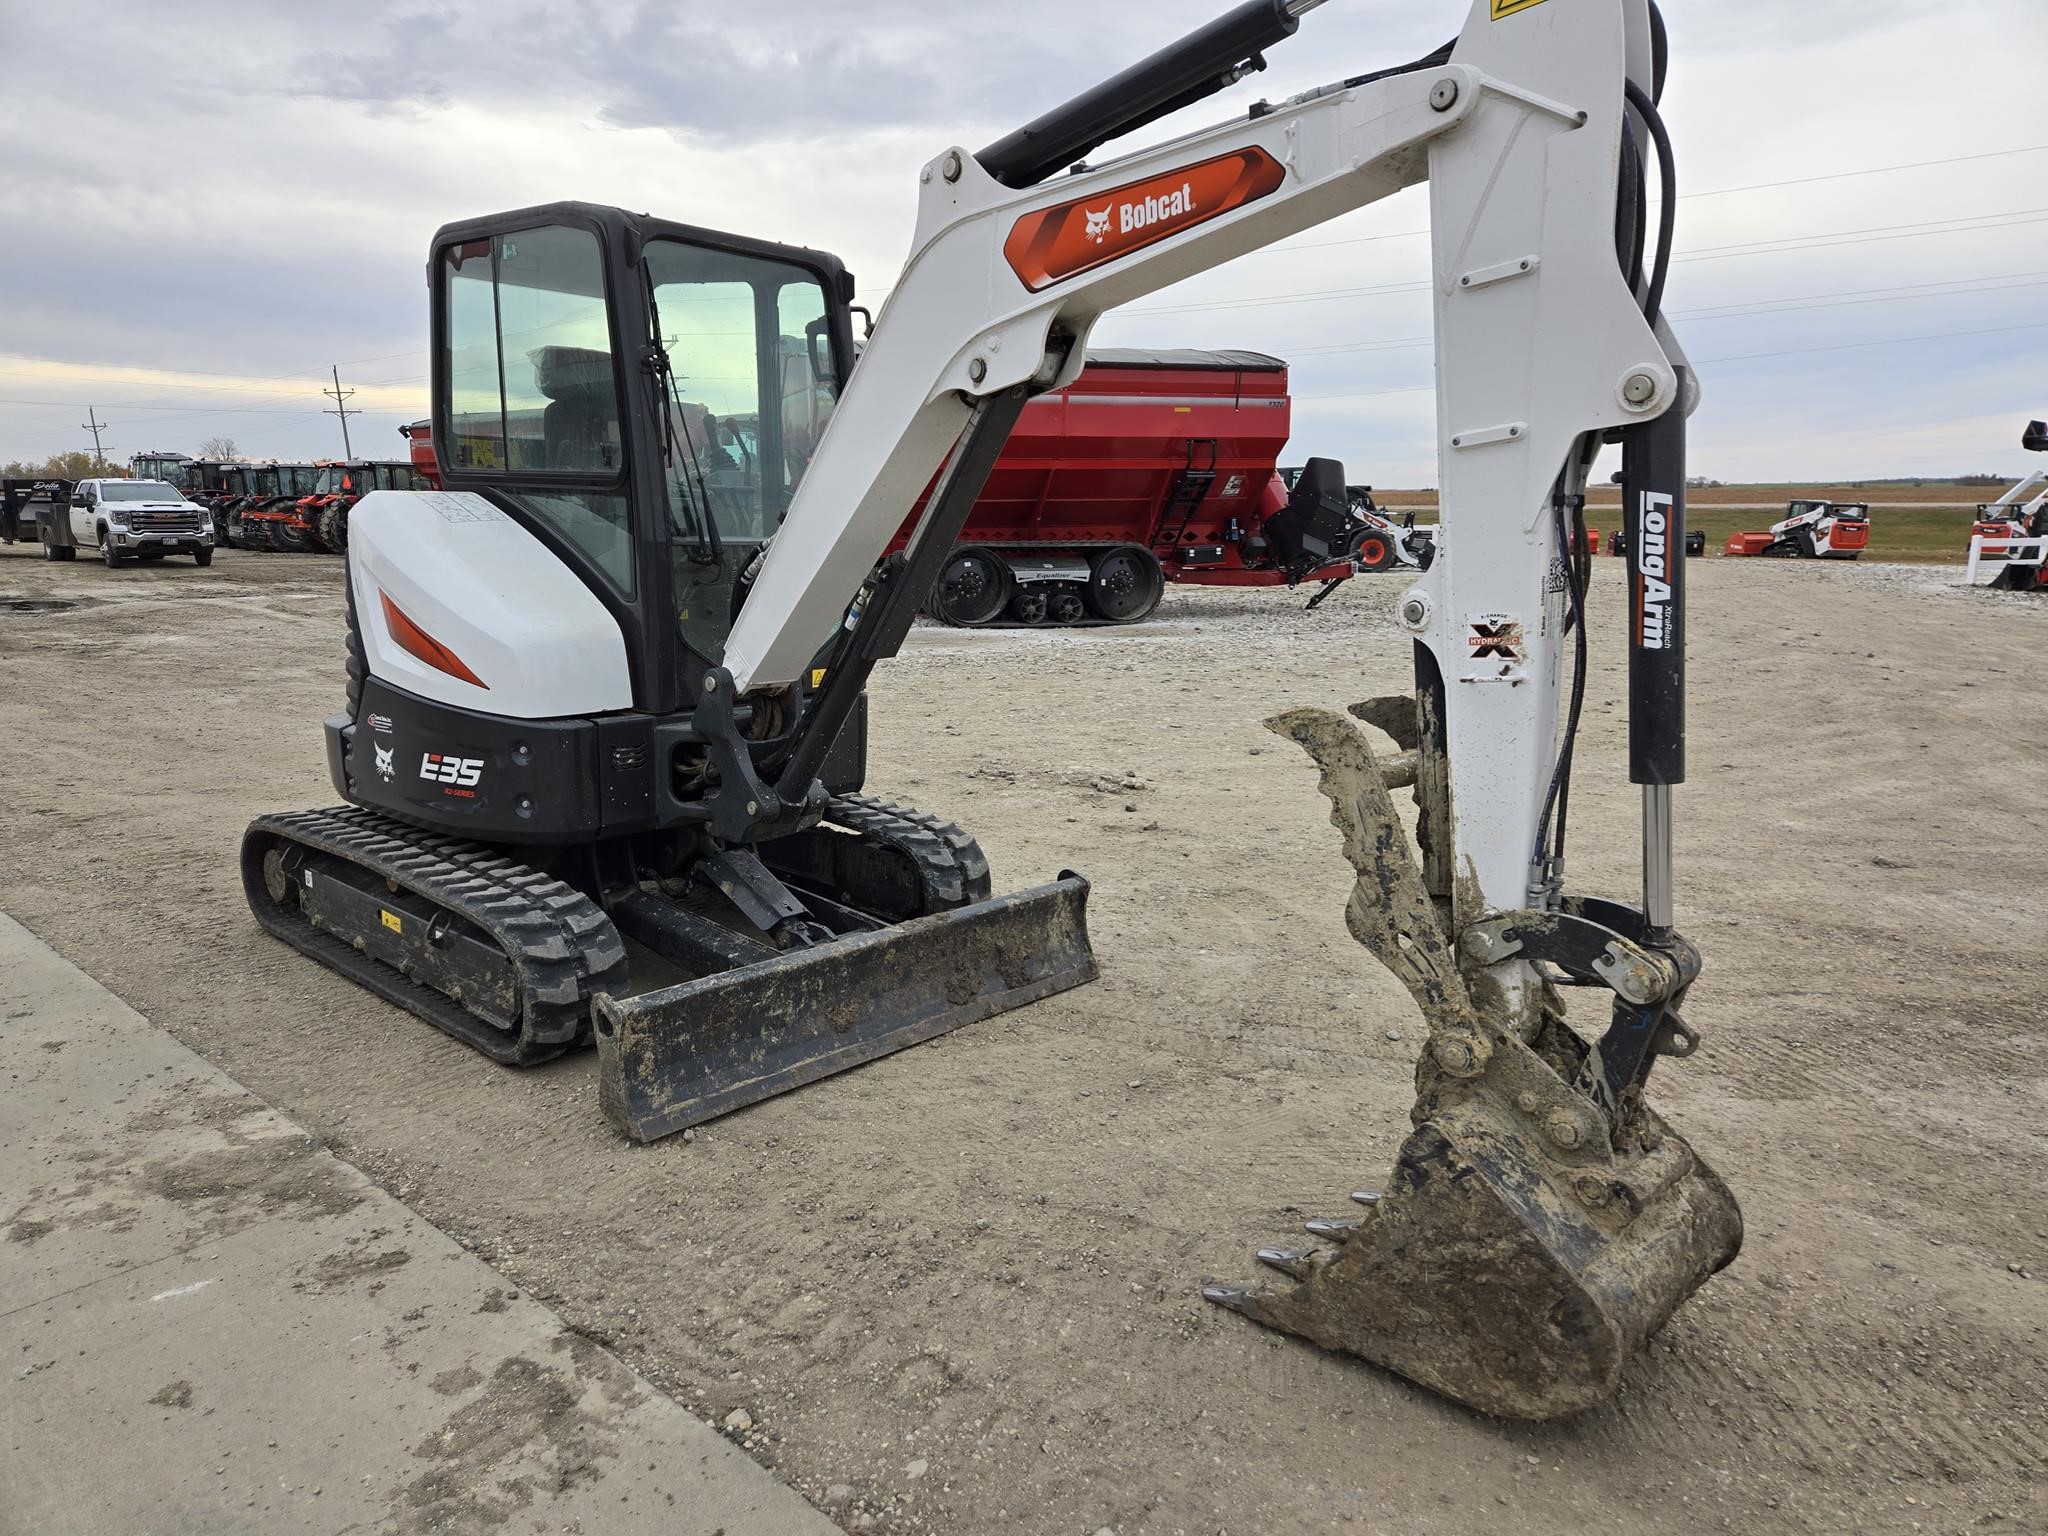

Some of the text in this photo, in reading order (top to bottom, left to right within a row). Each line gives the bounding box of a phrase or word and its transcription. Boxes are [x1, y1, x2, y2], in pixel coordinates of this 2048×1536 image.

[1119, 182, 1192, 234] Bobcat
[1639, 490, 1673, 650] LongArm
[1664, 605, 1673, 649] XtraReach
[419, 752, 485, 787] E35
